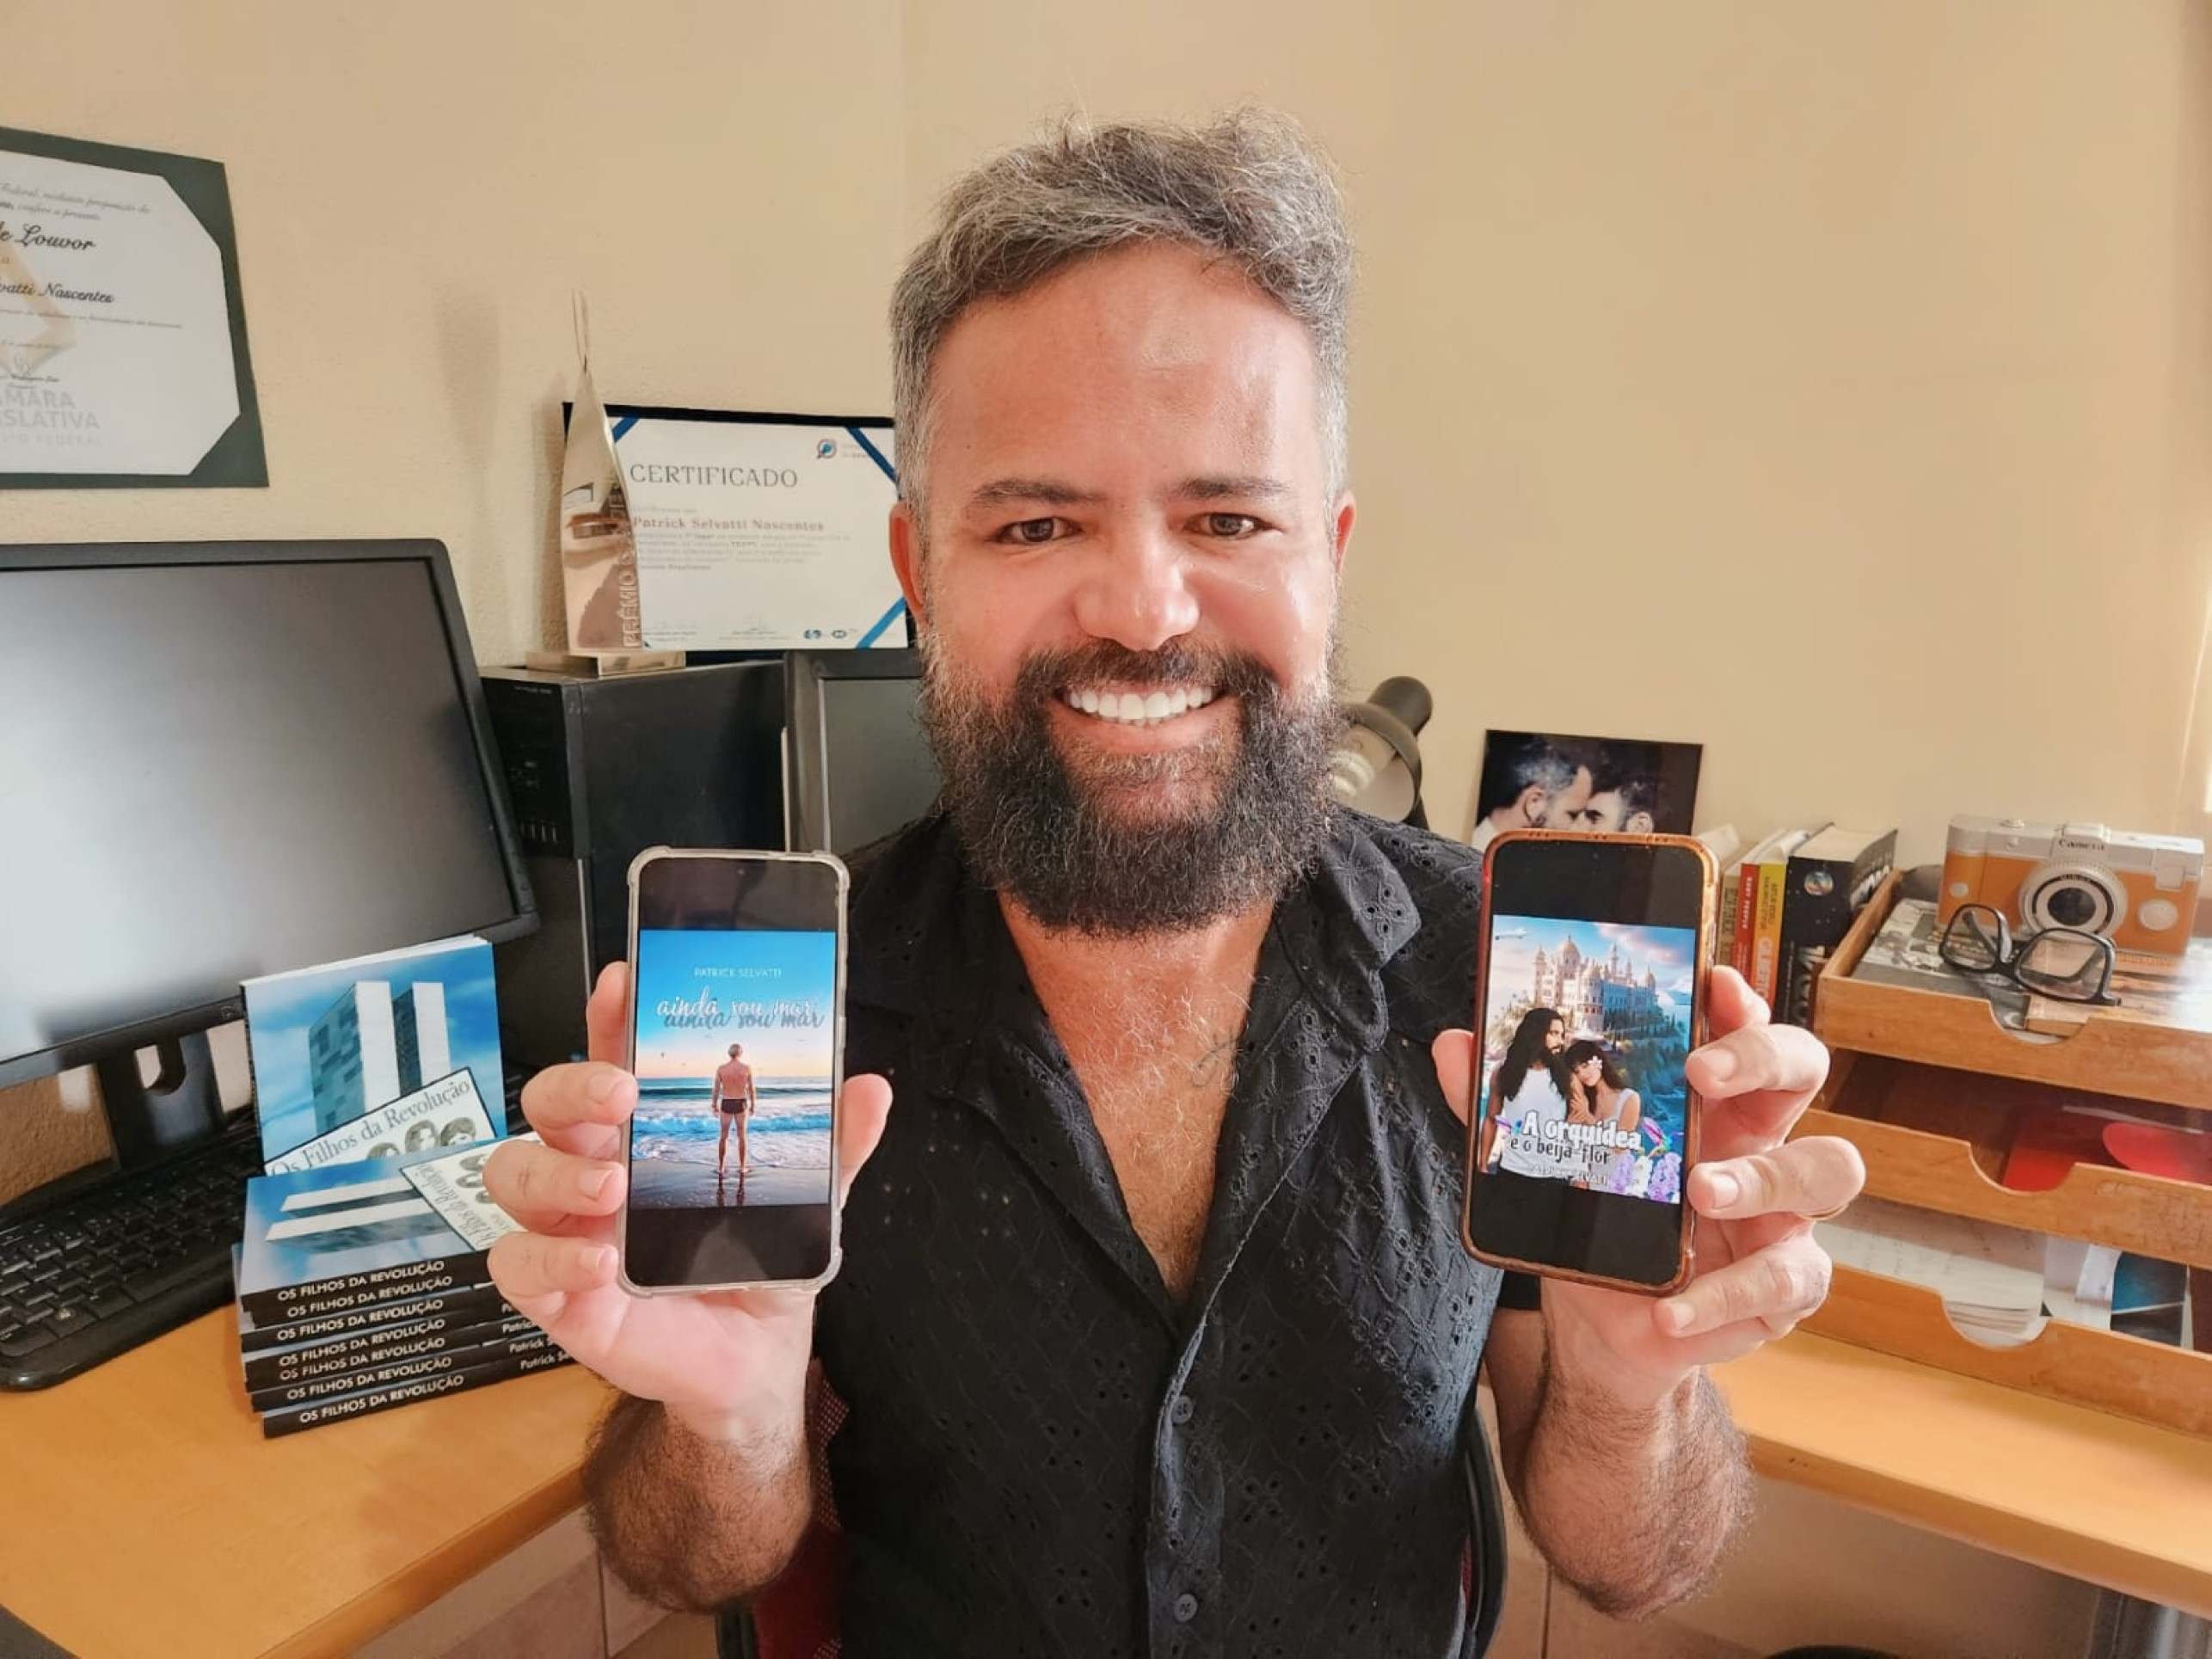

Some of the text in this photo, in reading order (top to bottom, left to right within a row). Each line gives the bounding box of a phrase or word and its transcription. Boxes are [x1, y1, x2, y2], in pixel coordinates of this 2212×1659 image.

[15, 223, 96, 250] Louvor
[39, 282, 114, 304] Nascentes
[0, 386, 76, 409] MARA
[0, 409, 101, 429] SLATIVA
[630, 464, 798, 489] CERTIFICADO
[634, 517, 825, 531] Patrick Selvatti Nascentes
[695, 968, 783, 978] PATRICK SELVATTI
[656, 986, 722, 1021] ainda
[304, 1138, 358, 1168] Filhos
[361, 1120, 384, 1141] da
[384, 1079, 470, 1129] Revolução
[1523, 1109, 1642, 1152] A orquídea
[1510, 1136, 1609, 1164] e o beija-flor
[278, 1260, 445, 1300] OS FILHOS DA REVOLUÇÃO
[287, 1305, 307, 1318] OS
[310, 1294, 354, 1312] FILHOS
[358, 1291, 377, 1303] DA
[277, 1299, 443, 1341] OS FILHOS DA REVOLUÇÃO
[279, 1318, 445, 1367] OS FILHOS DA REVOLUÇÃO
[510, 1337, 544, 1355] Patrick
[280, 1338, 445, 1380] OS FILHOS DA REVOLUÇÃO
[521, 1354, 556, 1370] Patrick
[287, 1387, 306, 1399] OS
[310, 1378, 353, 1395] FILHOS
[357, 1373, 375, 1385] DA
[300, 1375, 464, 1422] OS FILHOS DA REVOLUÇÃO
